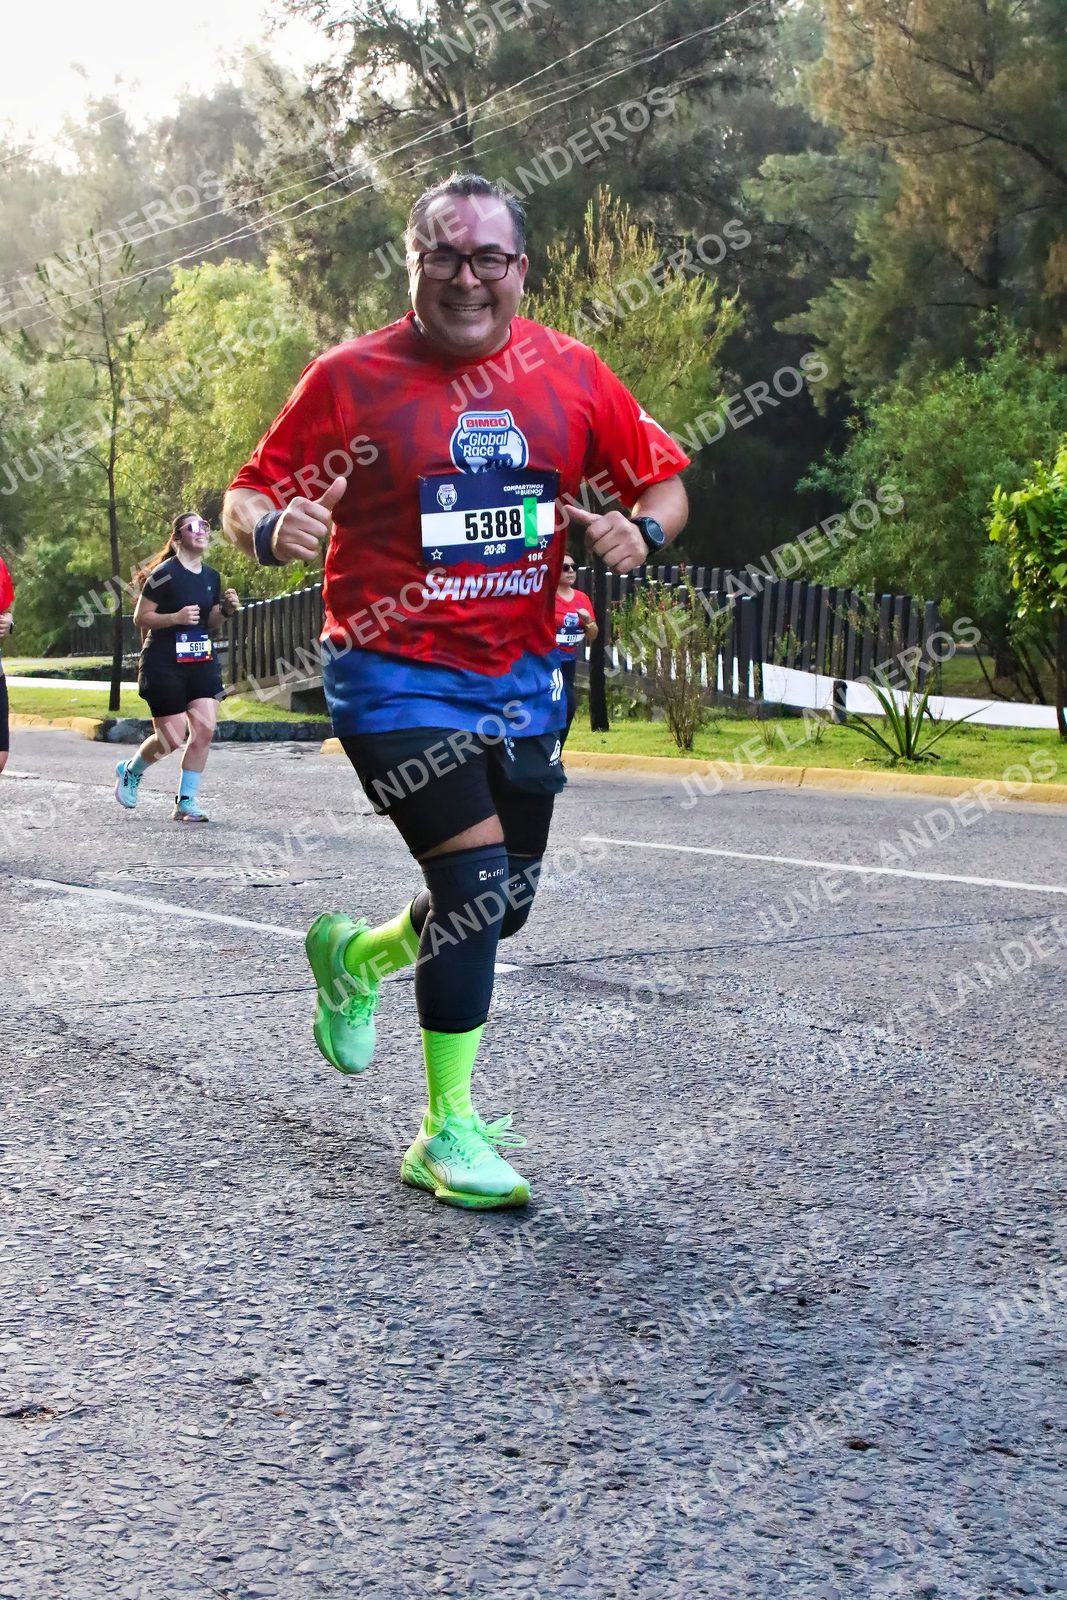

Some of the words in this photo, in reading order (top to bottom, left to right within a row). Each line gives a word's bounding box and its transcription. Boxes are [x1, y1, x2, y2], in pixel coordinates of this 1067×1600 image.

[466, 418, 507, 428] BIMBO
[469, 432, 507, 446] Global
[463, 445, 494, 457] Race
[465, 508, 522, 541] 5388
[527, 551, 544, 562] 10K
[422, 564, 549, 601] SANTIAGO
